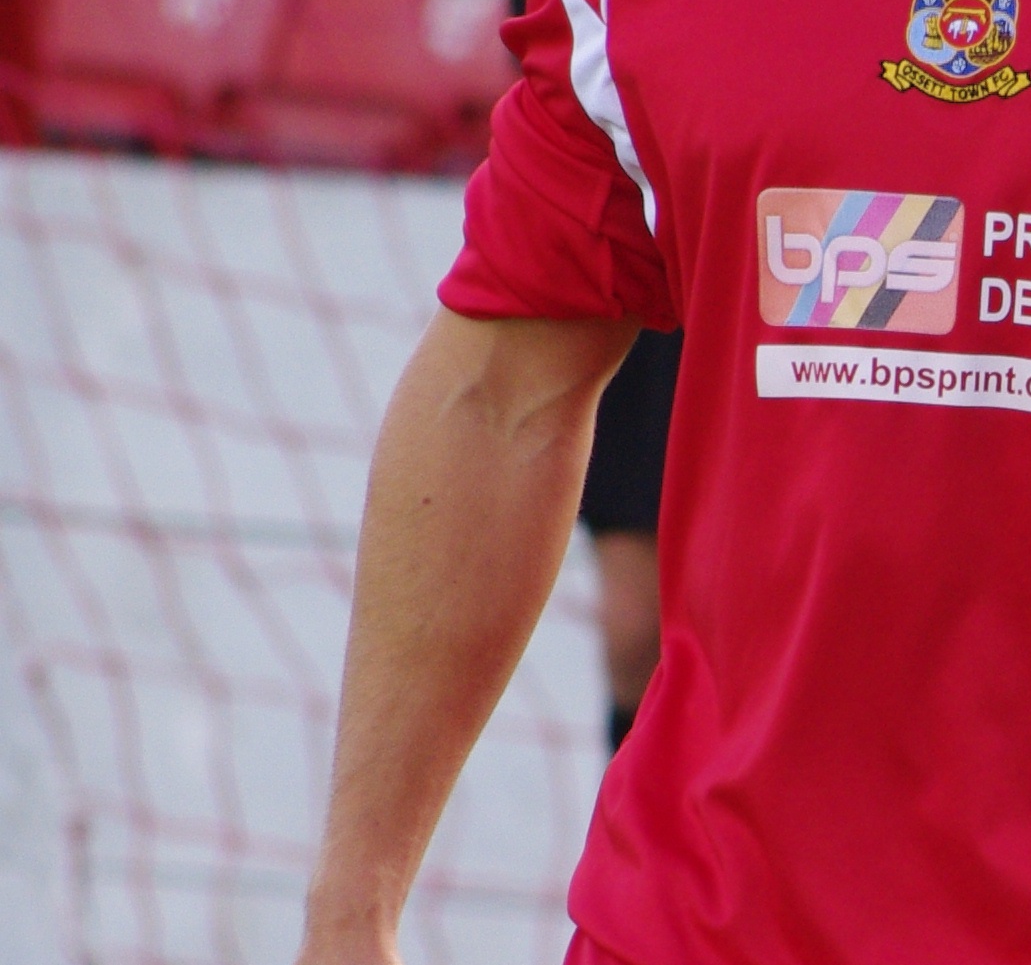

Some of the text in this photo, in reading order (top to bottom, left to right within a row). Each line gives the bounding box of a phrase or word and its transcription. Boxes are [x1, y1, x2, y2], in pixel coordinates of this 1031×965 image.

[902, 65, 1010, 101] OSSETT TOWN FC
[766, 215, 956, 303] bps
